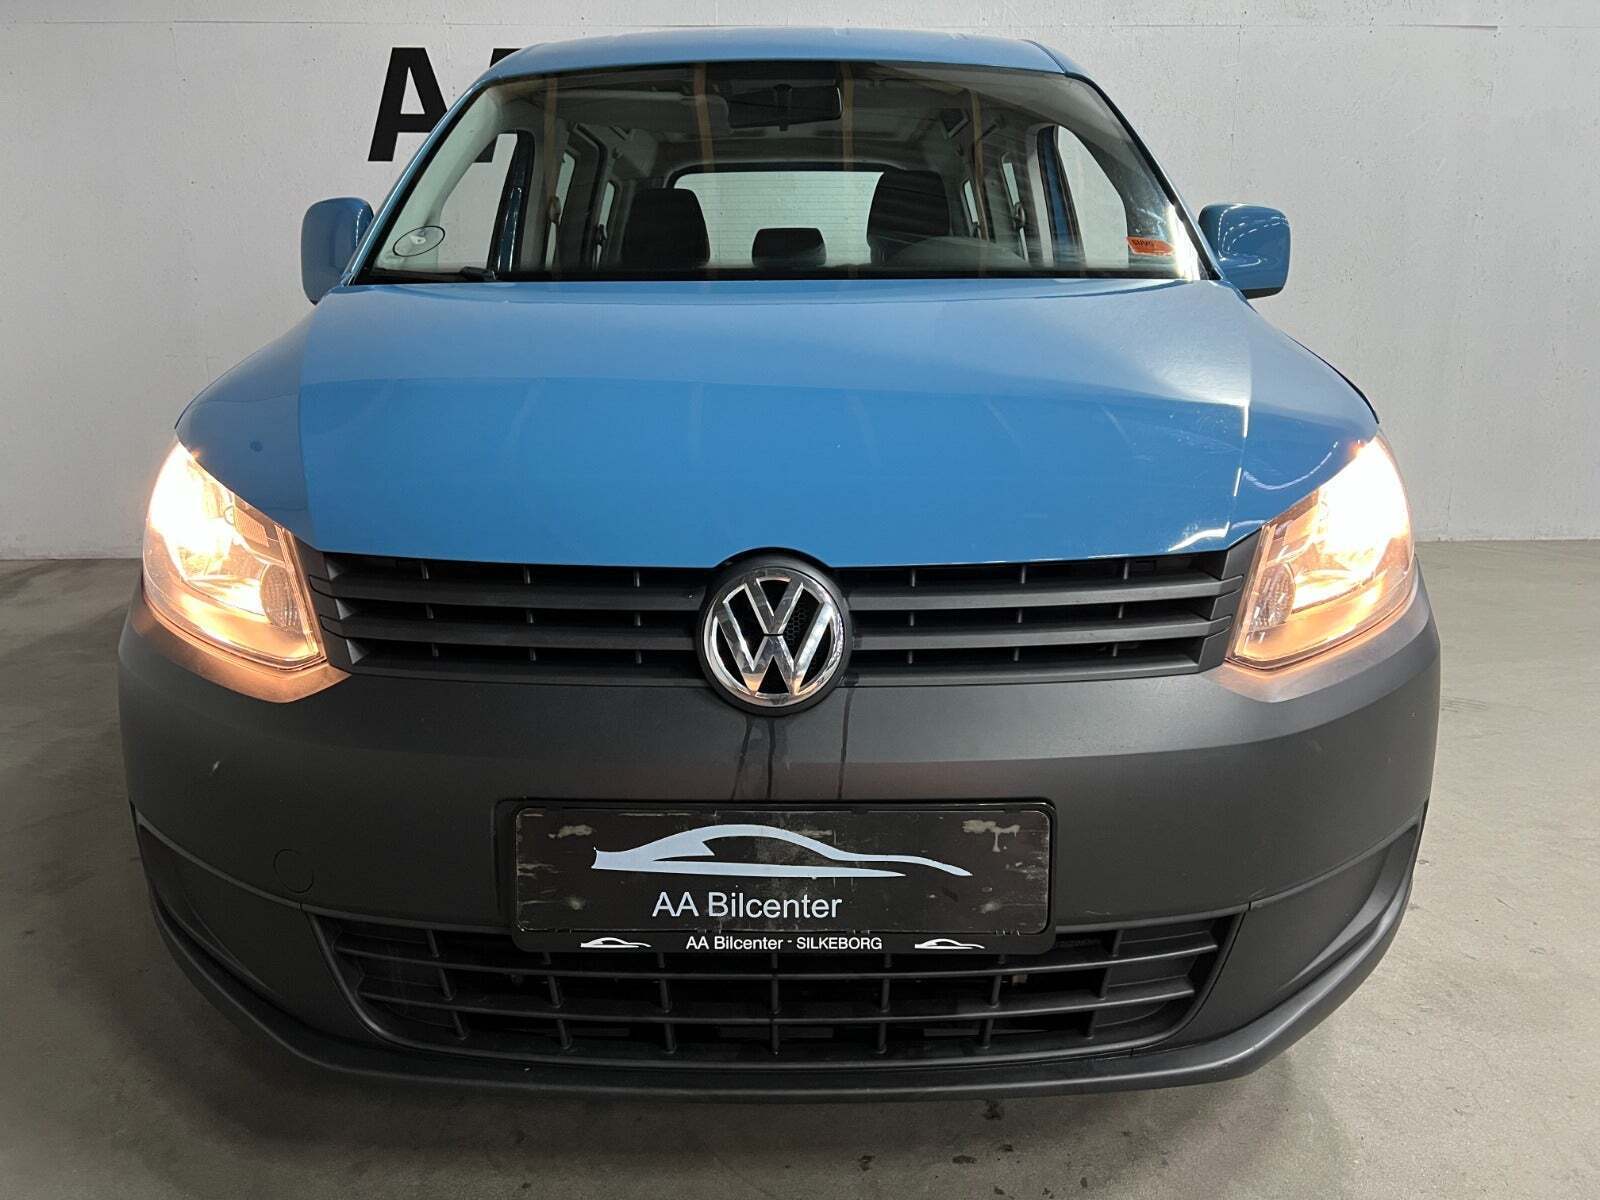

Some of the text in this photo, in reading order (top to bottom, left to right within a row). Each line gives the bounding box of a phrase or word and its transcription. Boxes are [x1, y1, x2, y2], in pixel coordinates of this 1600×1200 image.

[704, 568, 845, 706] VW
[651, 891, 843, 919] AA Bilcenter
[685, 936, 710, 950] AA
[714, 935, 783, 950] Bilcenter
[796, 936, 883, 950] SILKEBORG
